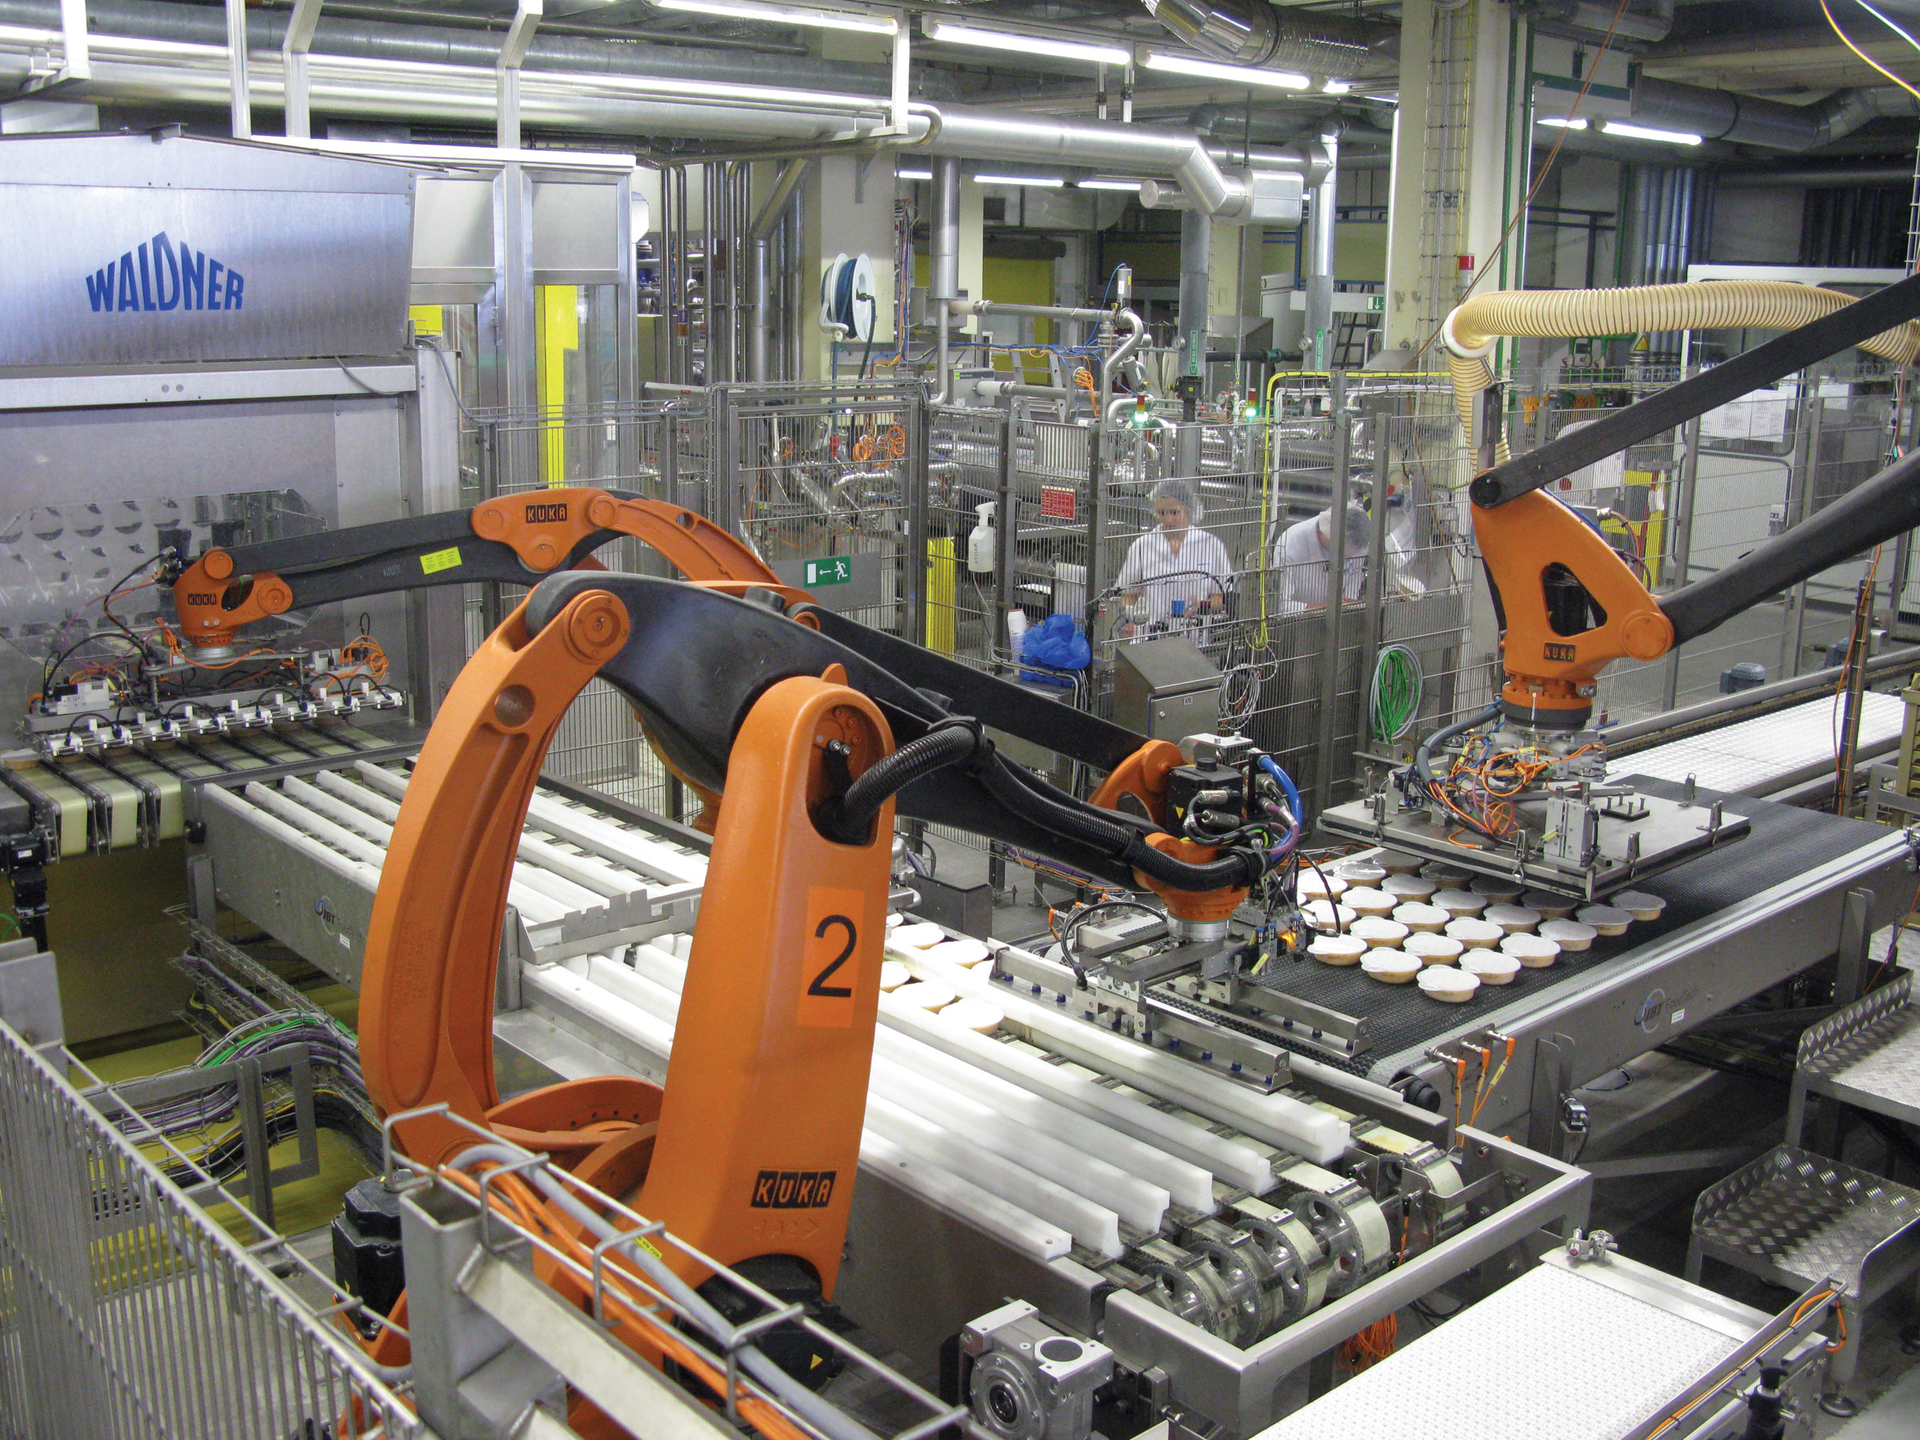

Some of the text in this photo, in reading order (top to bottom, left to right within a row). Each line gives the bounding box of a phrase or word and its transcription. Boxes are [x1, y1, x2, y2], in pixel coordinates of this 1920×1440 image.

[86, 231, 244, 312] WALDNER
[527, 505, 566, 522] KUKA
[189, 594, 216, 605] KUKA
[1544, 644, 1575, 660] KUKA
[807, 914, 857, 998] 2
[753, 1174, 834, 1206] KUKA
